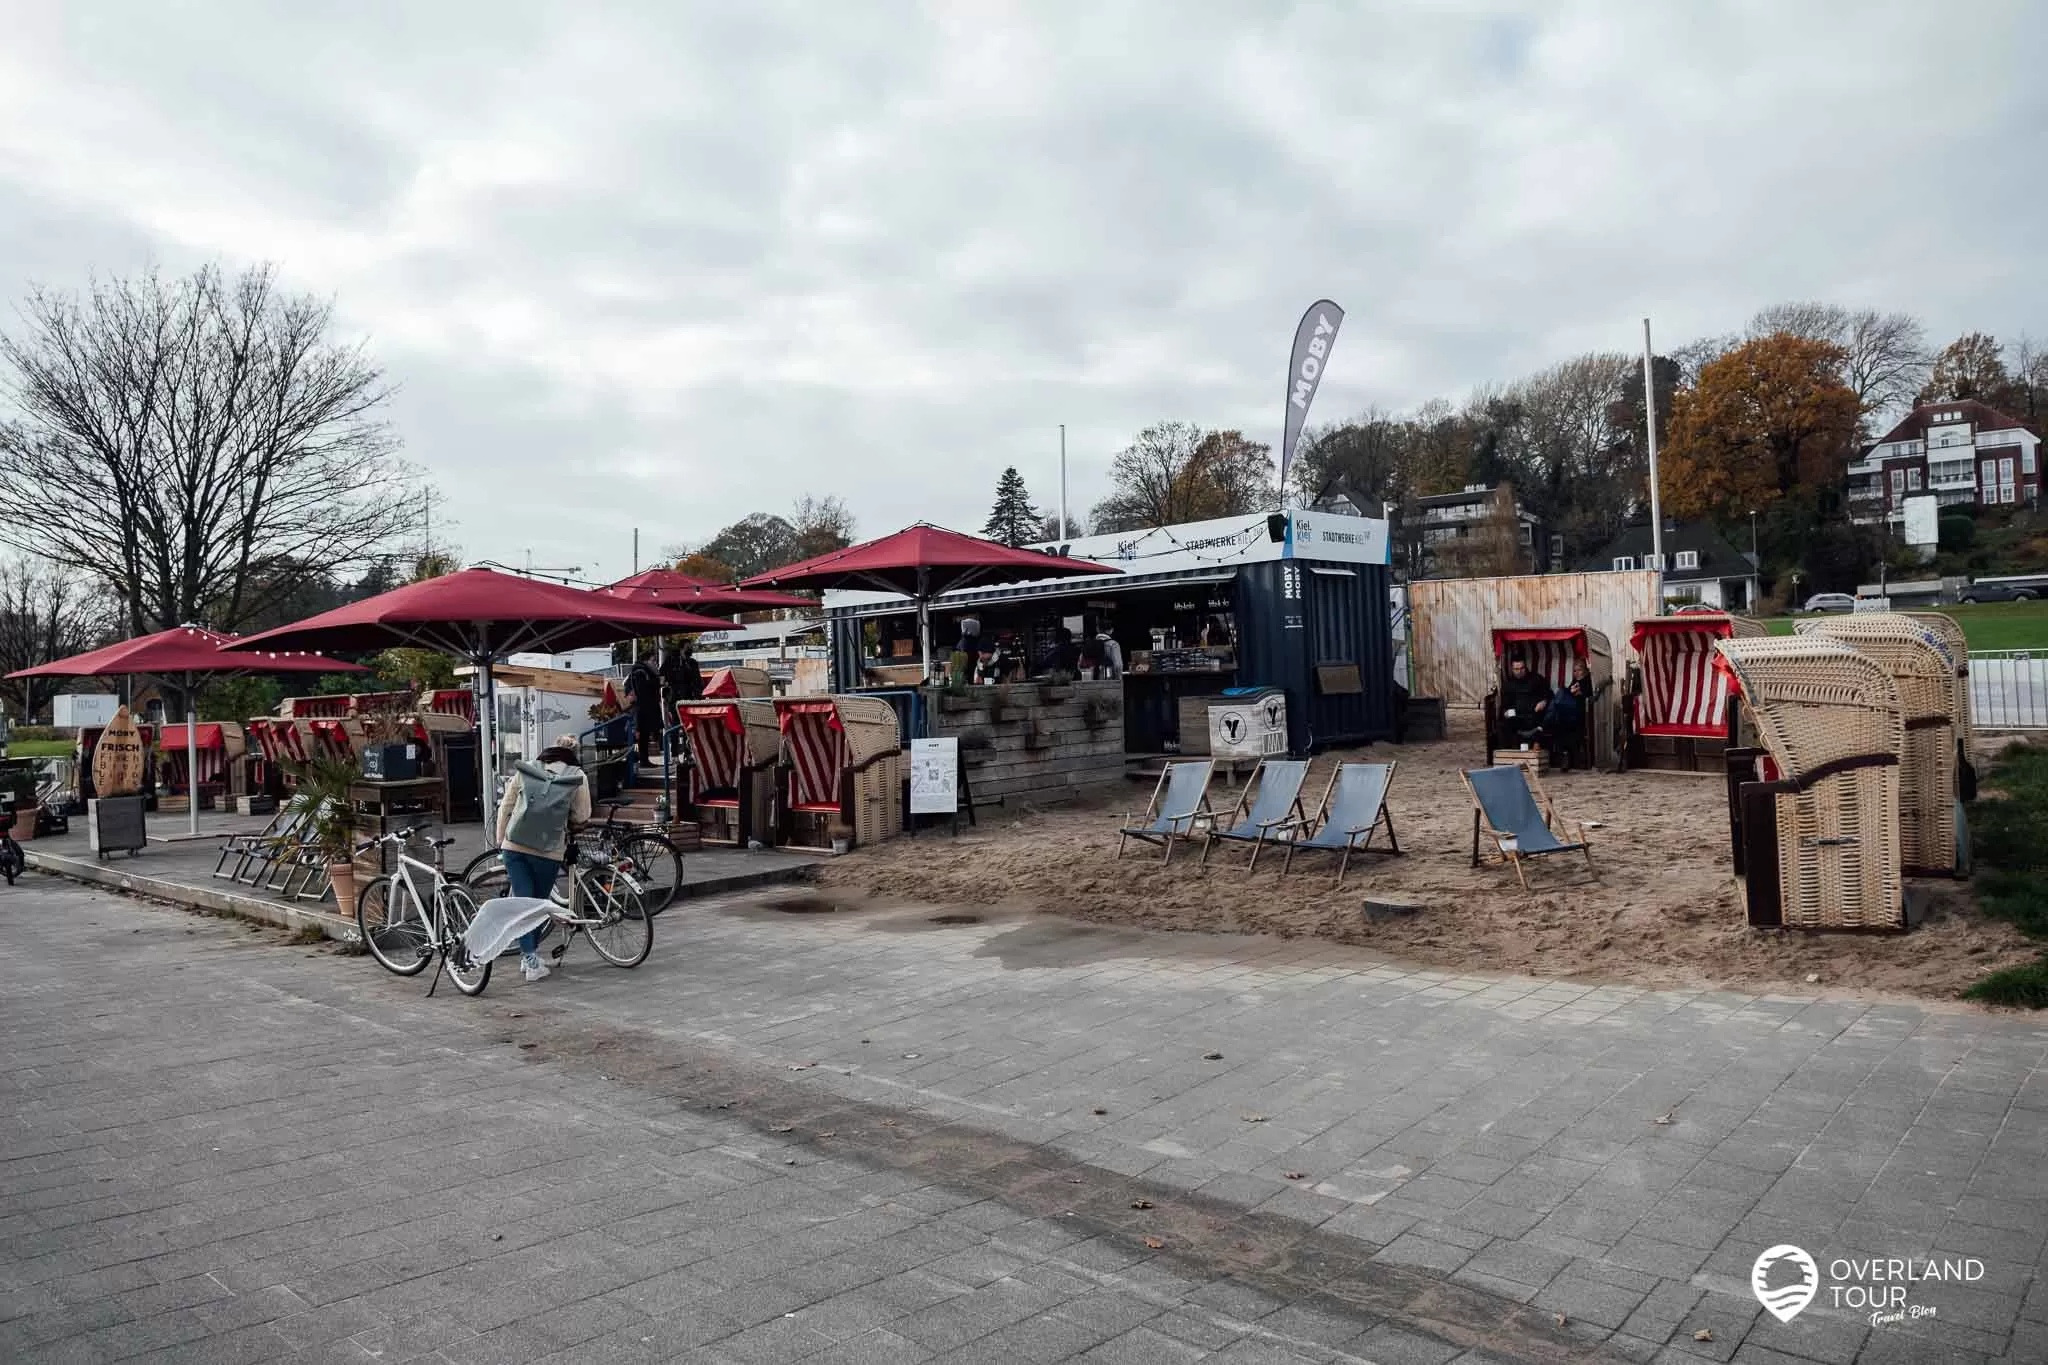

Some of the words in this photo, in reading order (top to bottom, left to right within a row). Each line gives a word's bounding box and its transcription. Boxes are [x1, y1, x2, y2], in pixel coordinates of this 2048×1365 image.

[1291, 313, 1334, 409] MOBY
[1284, 566, 1293, 599] MOBY
[101, 743, 140, 752] FRISCH
